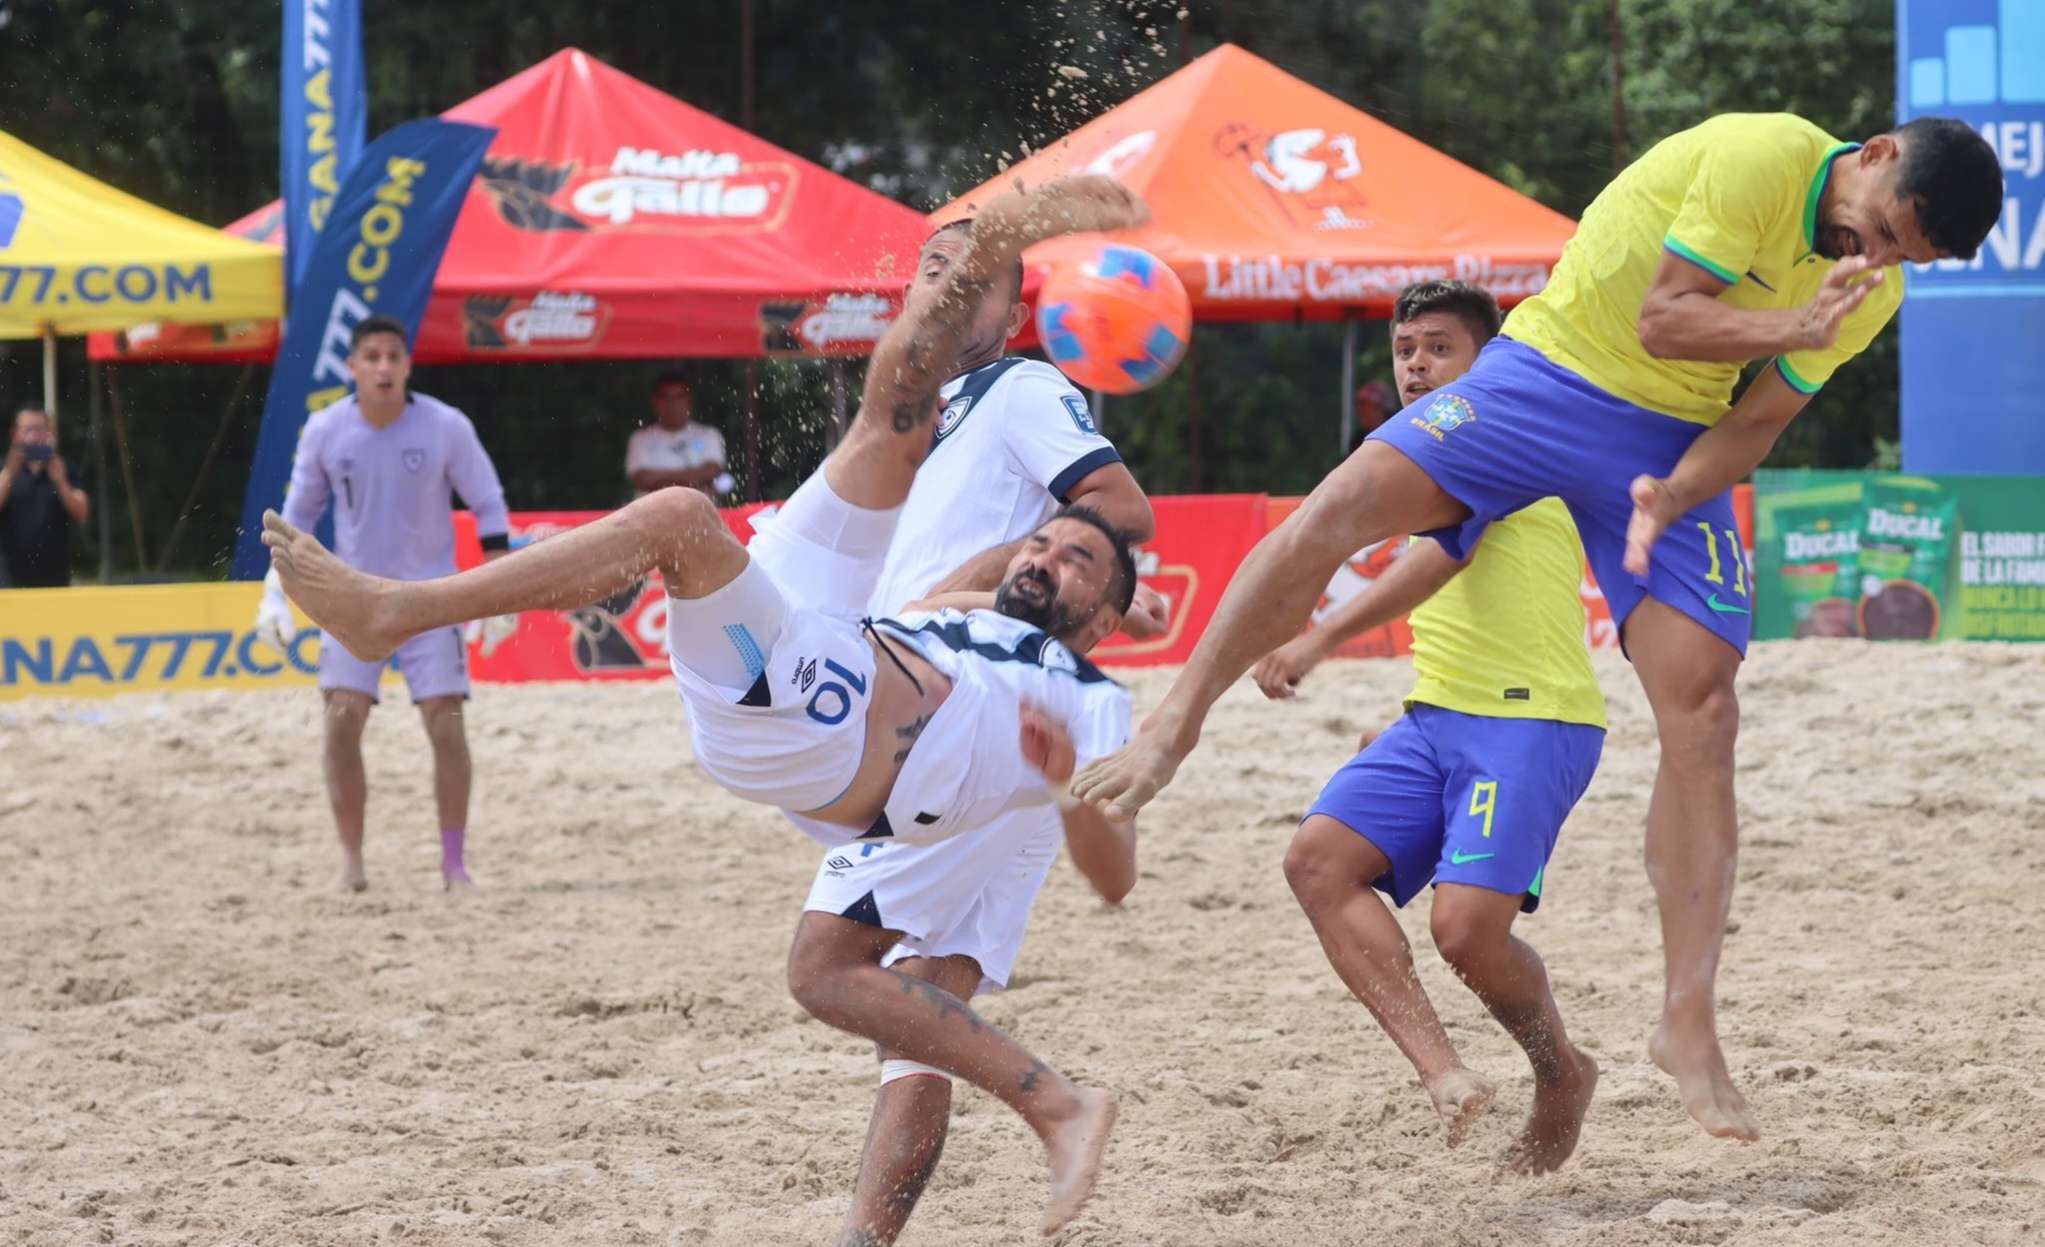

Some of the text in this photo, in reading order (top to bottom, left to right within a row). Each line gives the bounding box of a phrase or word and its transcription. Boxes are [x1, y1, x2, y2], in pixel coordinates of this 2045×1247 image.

[573, 175, 768, 224] Gallo
[1204, 255, 1300, 299] Little
[342, 477, 353, 509] 1
[1783, 530, 1862, 560] DUCAL
[1867, 507, 1943, 541] DUCAL
[1697, 522, 1746, 597] 11
[806, 657, 866, 725] 10
[1469, 780, 1497, 838] 9
